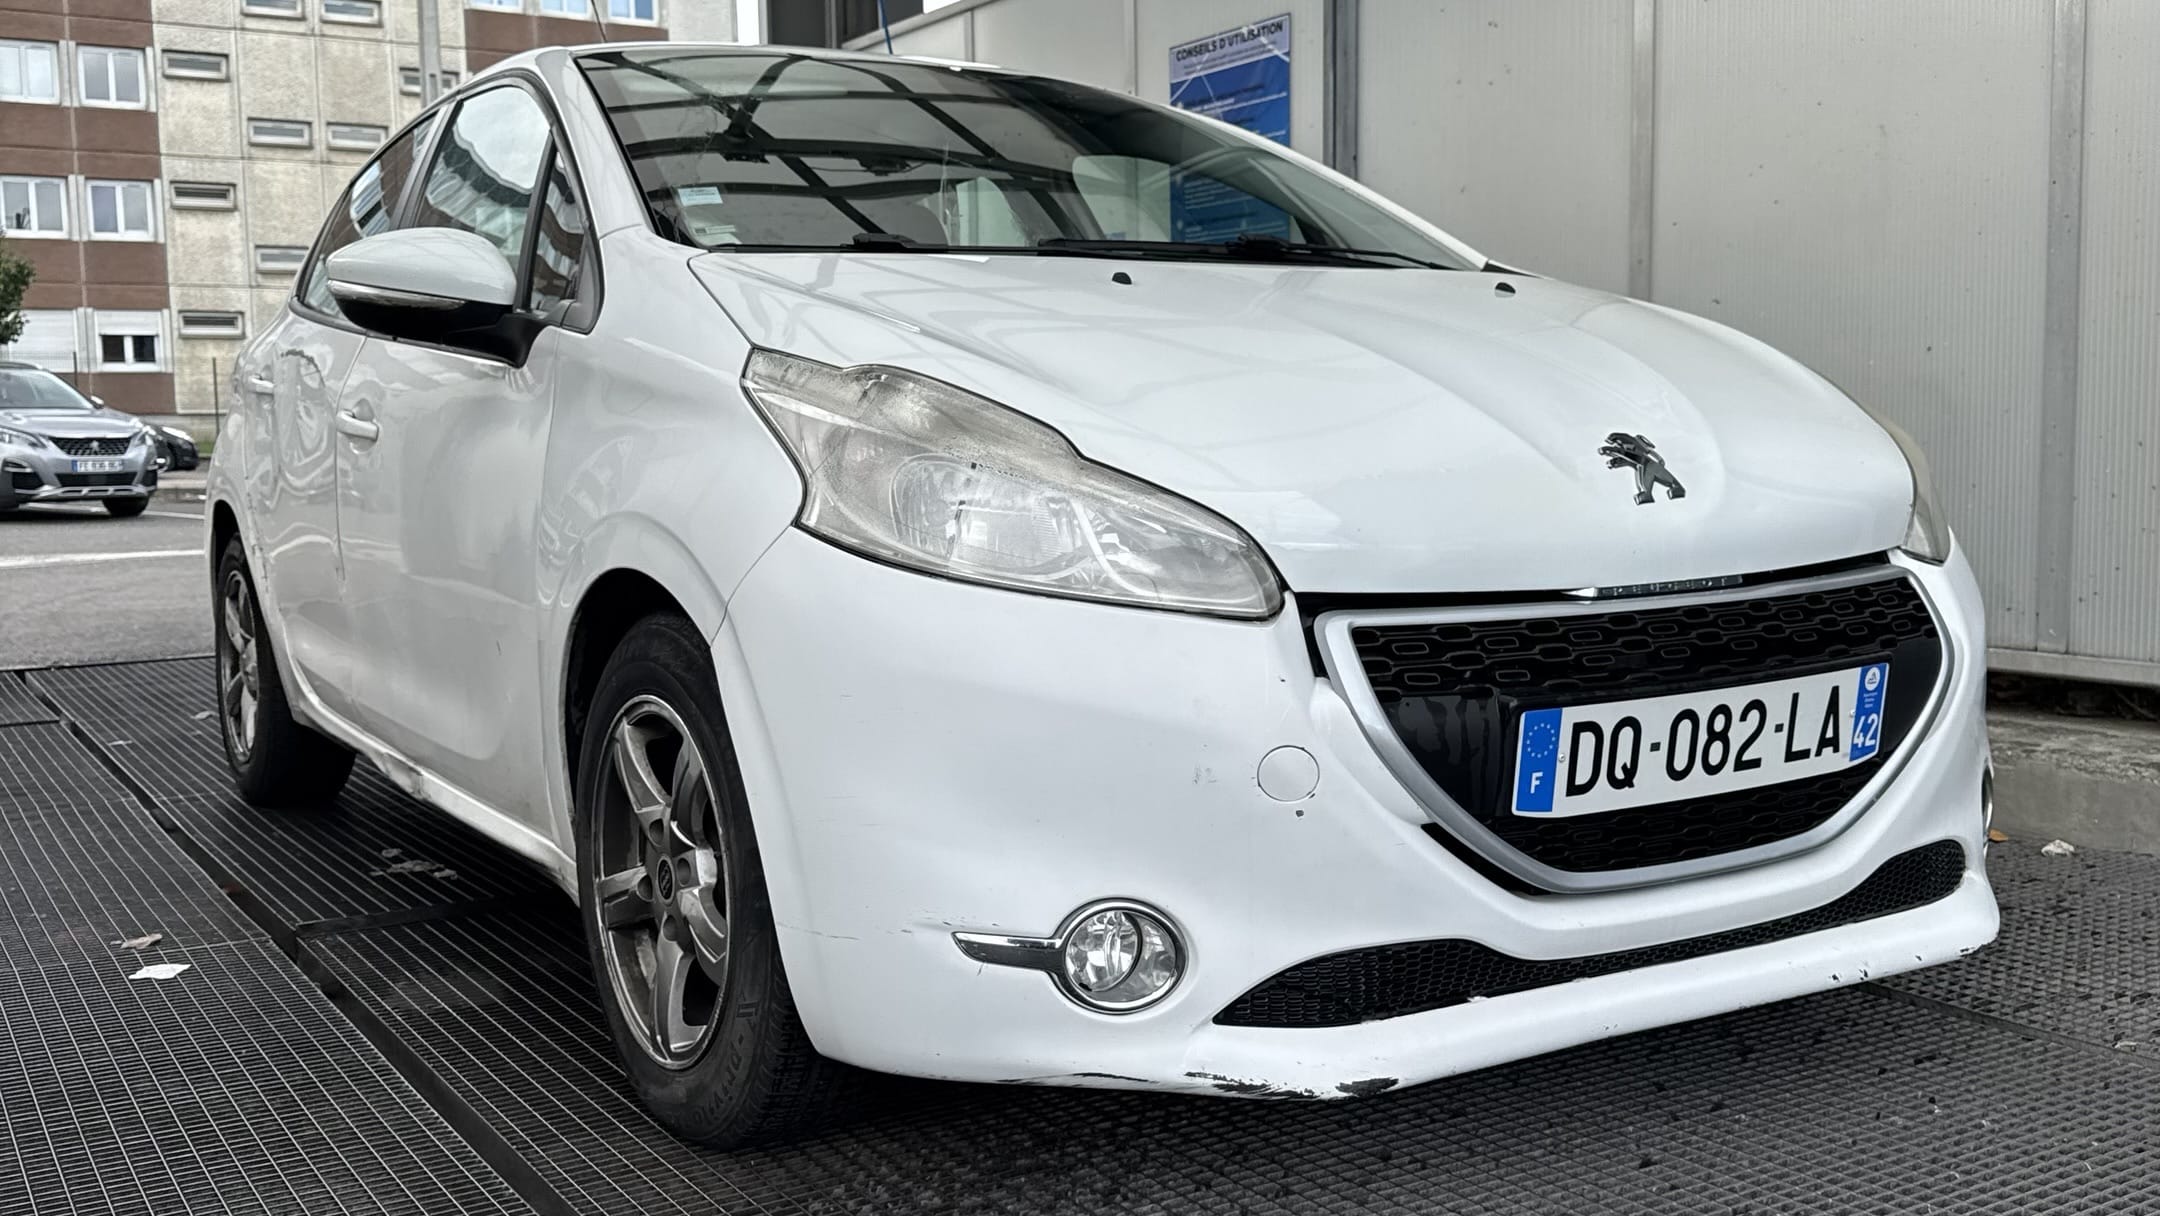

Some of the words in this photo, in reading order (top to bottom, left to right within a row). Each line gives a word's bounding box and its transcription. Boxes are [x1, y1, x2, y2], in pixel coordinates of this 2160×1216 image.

[1176, 39, 1216, 61] CONSEILS
[1565, 685, 1841, 797] DQ-082-LA
[1853, 713, 1879, 748] 42
[1530, 771, 1543, 794] F
